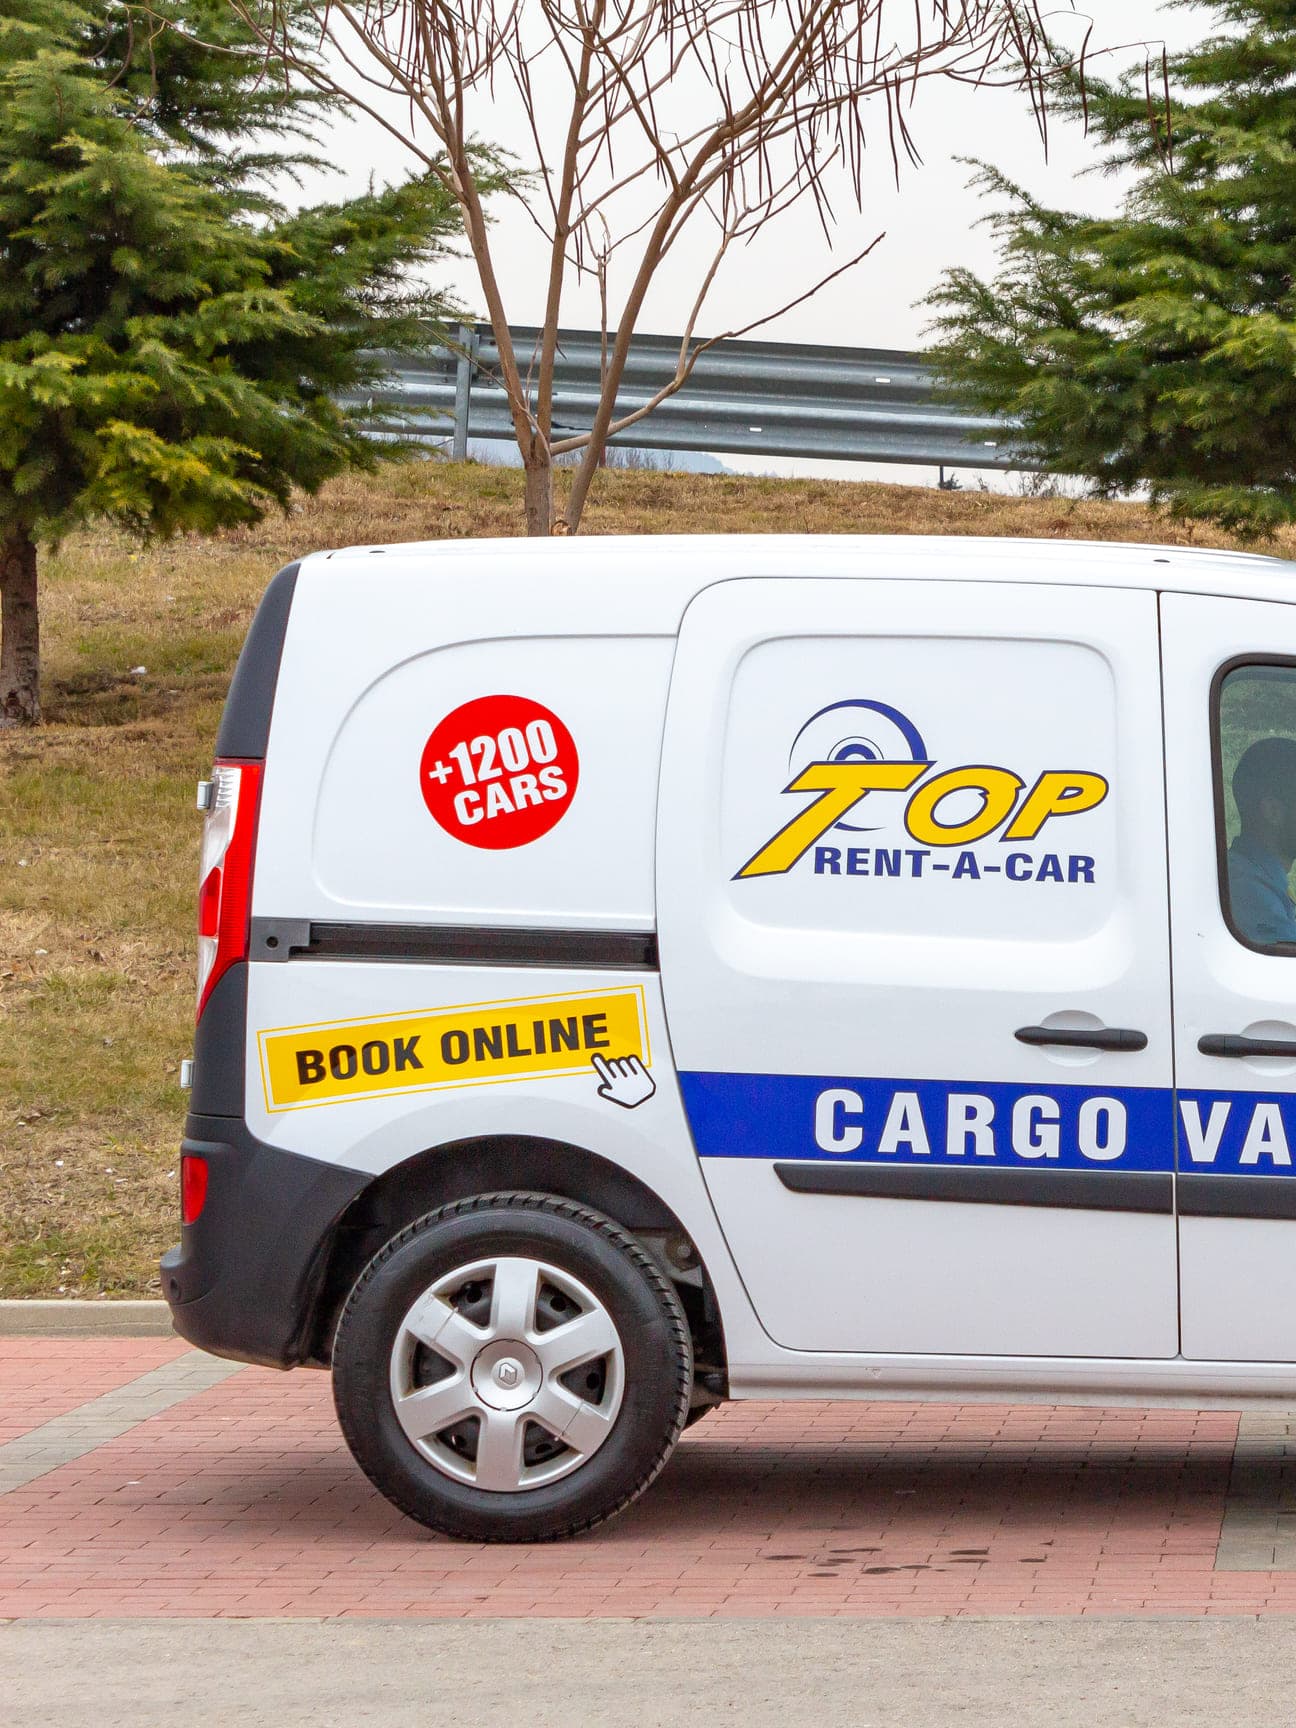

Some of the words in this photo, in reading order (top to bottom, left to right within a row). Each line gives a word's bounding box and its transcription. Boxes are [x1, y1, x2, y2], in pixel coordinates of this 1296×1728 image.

[429, 719, 557, 785] +1200
[453, 765, 567, 826] CARS
[730, 760, 1110, 881] TOP
[814, 846, 1096, 884] RENT-A-CAR
[295, 1035, 424, 1086] BOOK
[440, 1013, 610, 1066] ONLINE
[814, 1087, 1128, 1161] CARGO
